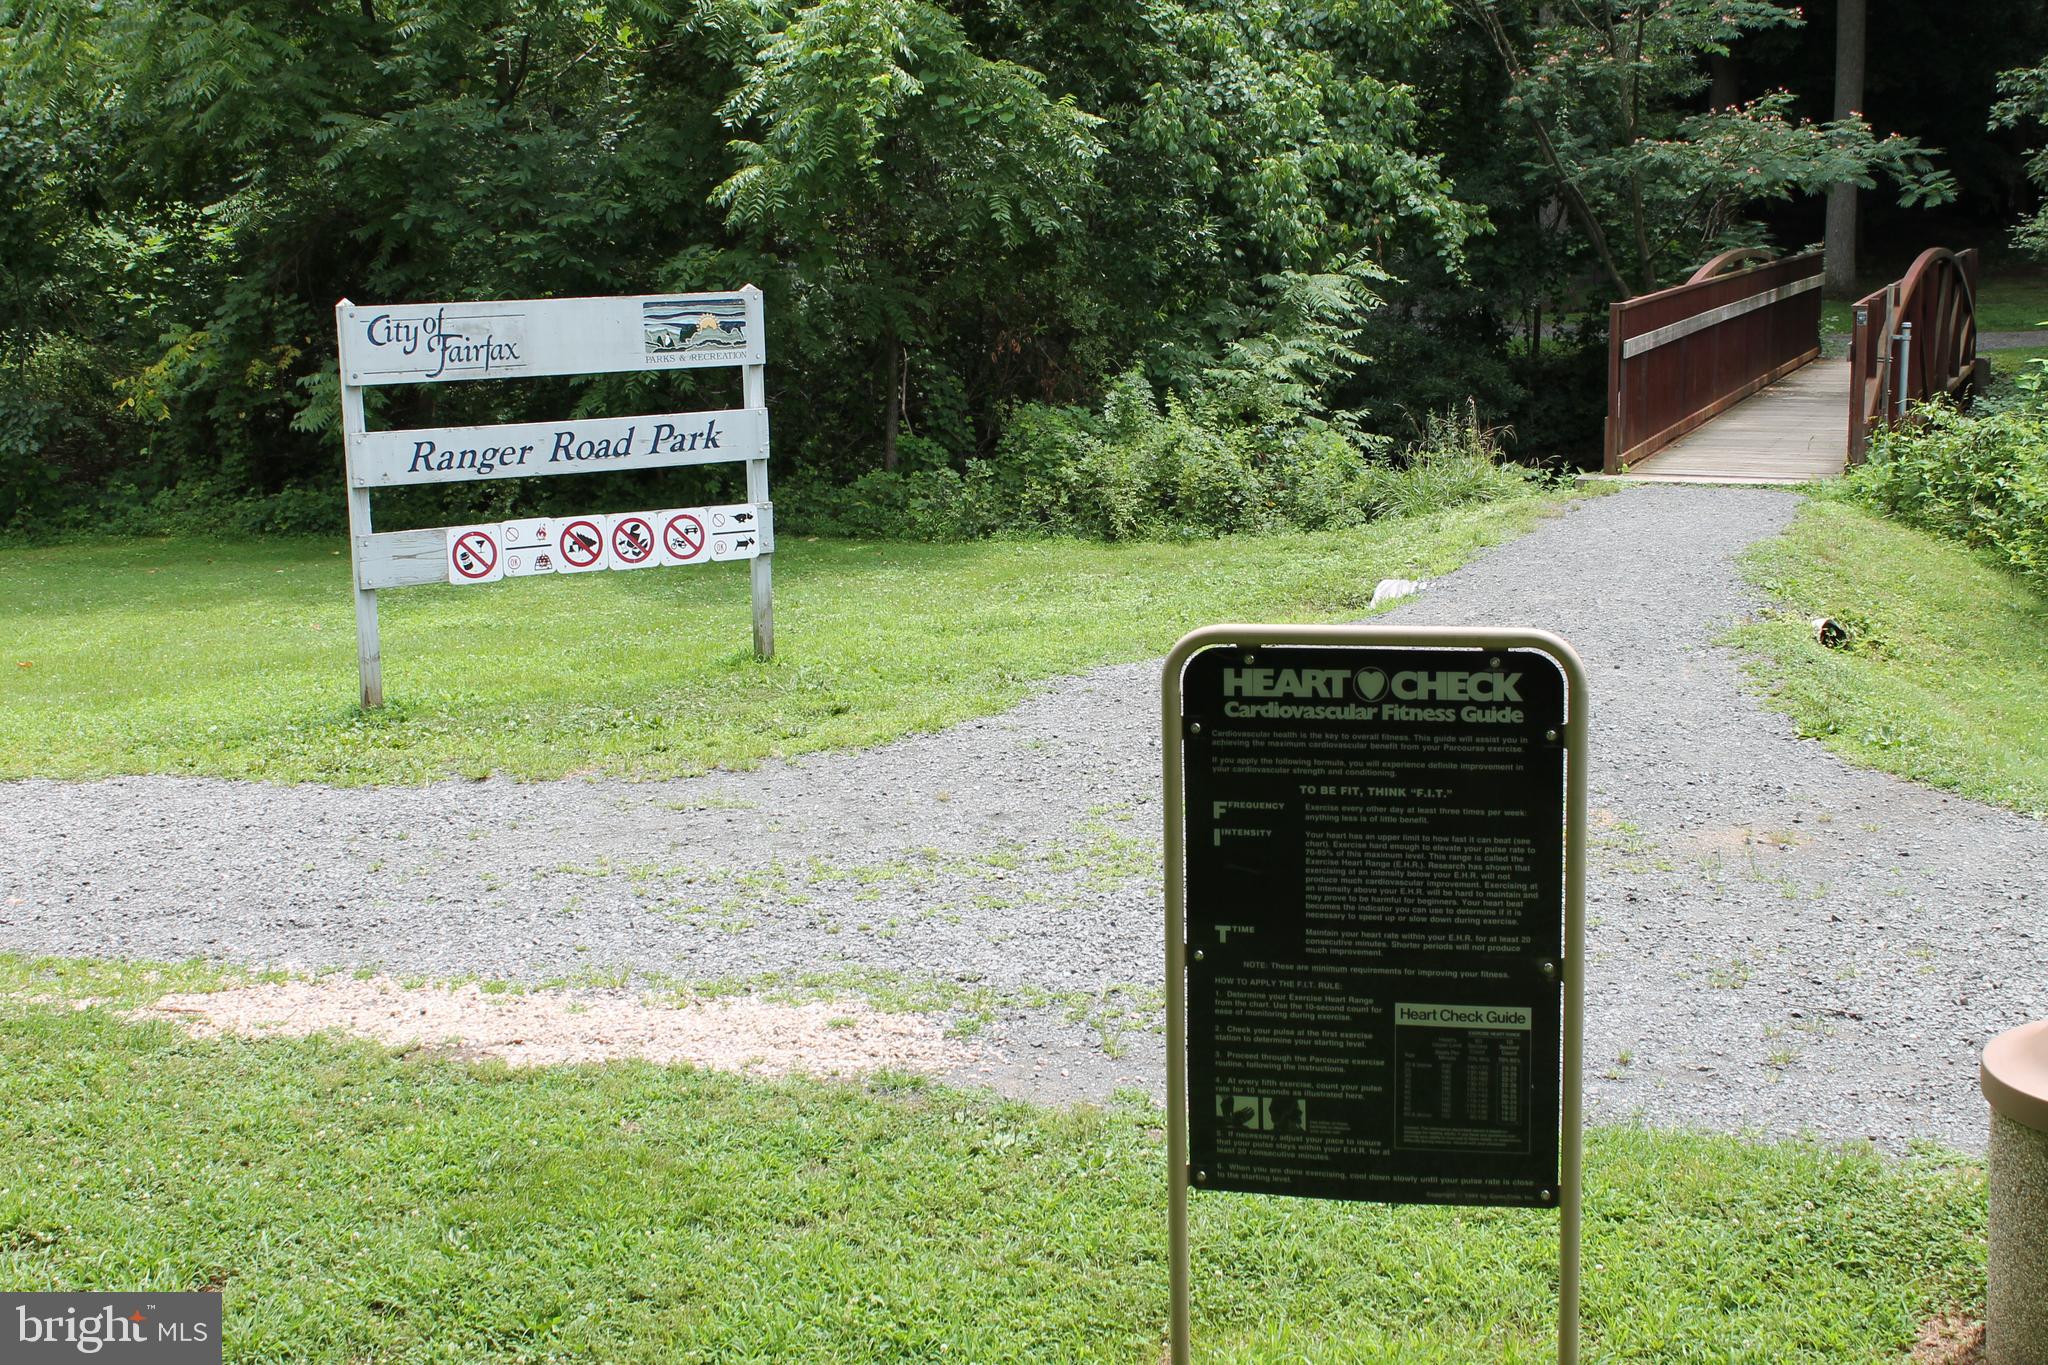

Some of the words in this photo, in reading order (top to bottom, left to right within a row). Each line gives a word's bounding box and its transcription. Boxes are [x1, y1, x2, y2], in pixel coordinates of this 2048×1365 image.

[367, 315, 419, 355] City
[423, 307, 445, 345] of
[426, 334, 520, 378] Fairfax
[645, 355, 675, 363] PARKS
[690, 351, 747, 361] RECREATION
[407, 441, 534, 475] Ranger
[549, 426, 635, 463] Road
[648, 419, 723, 455] Park
[1223, 668, 1351, 698] HEART
[1391, 670, 1523, 702] CHECK
[1224, 701, 1378, 721] Cardiovascular
[1382, 703, 1456, 722] Fitness
[1460, 706, 1524, 723] Guide
[1211, 729, 1270, 737] Cardiovascular
[1324, 732, 1339, 741] key
[1433, 735, 1456, 743] guide
[1211, 738, 1250, 748] achieving
[1308, 741, 1367, 749] cardiovascular
[1232, 765, 1290, 774] cardiovascular
[1292, 767, 1326, 776] strength
[1236, 757, 1258, 765] apply
[1275, 757, 1312, 767] following
[1381, 760, 1426, 770] experience
[1427, 761, 1458, 769] definite
[1460, 762, 1514, 772] improvement
[1300, 785, 1316, 794] TO
[1320, 786, 1336, 795] BE
[1368, 787, 1406, 797] THINK
[1305, 803, 1339, 811] Exercise
[1389, 806, 1404, 814] day
[1417, 806, 1437, 814] least
[1305, 813, 1340, 822] anything
[1379, 815, 1397, 823] little
[1326, 831, 1347, 839] heart
[1493, 836, 1511, 844] beat
[1389, 842, 1420, 852] enough
[1464, 846, 1482, 854] your
[1484, 845, 1507, 854] pulse
[1305, 938, 1353, 946] consecutive
[1423, 942, 1453, 951] periods
[1471, 943, 1485, 951] not
[1487, 944, 1521, 954] produce
[1305, 946, 1328, 954] much
[1271, 962, 1294, 970] These
[1311, 964, 1348, 972] minimum
[1350, 965, 1402, 976] requirements
[1417, 968, 1458, 978] improving
[1214, 977, 1234, 985] HOW
[1250, 979, 1276, 987] APPLY
[1279, 980, 1294, 988] THE
[1400, 1008, 1437, 1021] Heart
[1440, 1009, 1483, 1023] Check
[1486, 1011, 1526, 1024] Guide
[1226, 1025, 1251, 1033] Check
[1253, 1028, 1271, 1036] your
[1273, 1027, 1295, 1037] pulse
[1339, 1031, 1373, 1039] exercise
[1215, 1033, 1241, 1041] station
[1253, 1035, 1292, 1044] determine
[1314, 1038, 1344, 1048] starting
